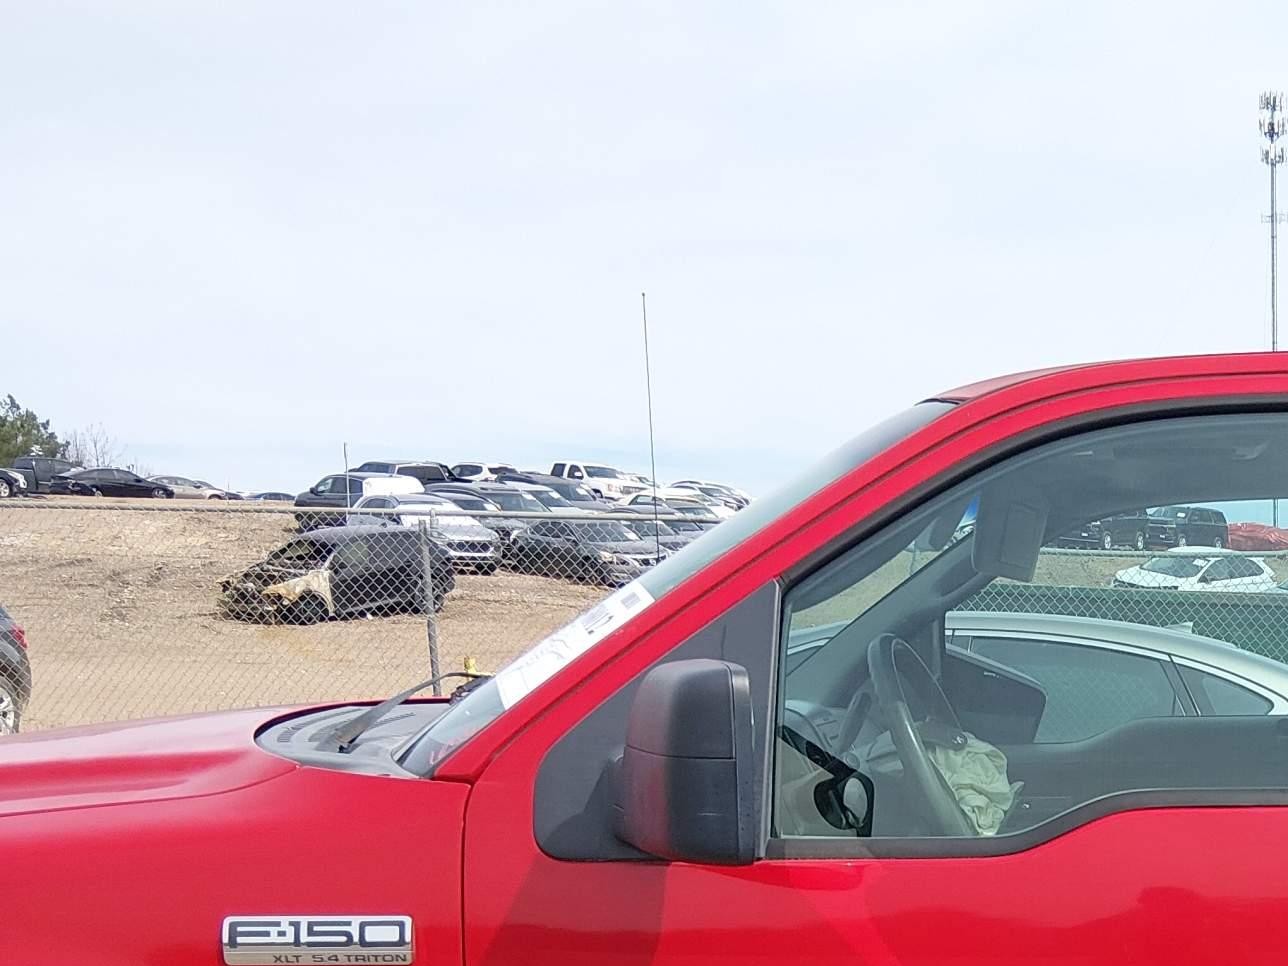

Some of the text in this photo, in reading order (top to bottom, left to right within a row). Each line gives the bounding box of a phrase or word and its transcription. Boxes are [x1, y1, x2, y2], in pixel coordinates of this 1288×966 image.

[228, 920, 406, 948] F-150
[273, 954, 302, 963] XLT
[344, 954, 407, 963] TRITON
